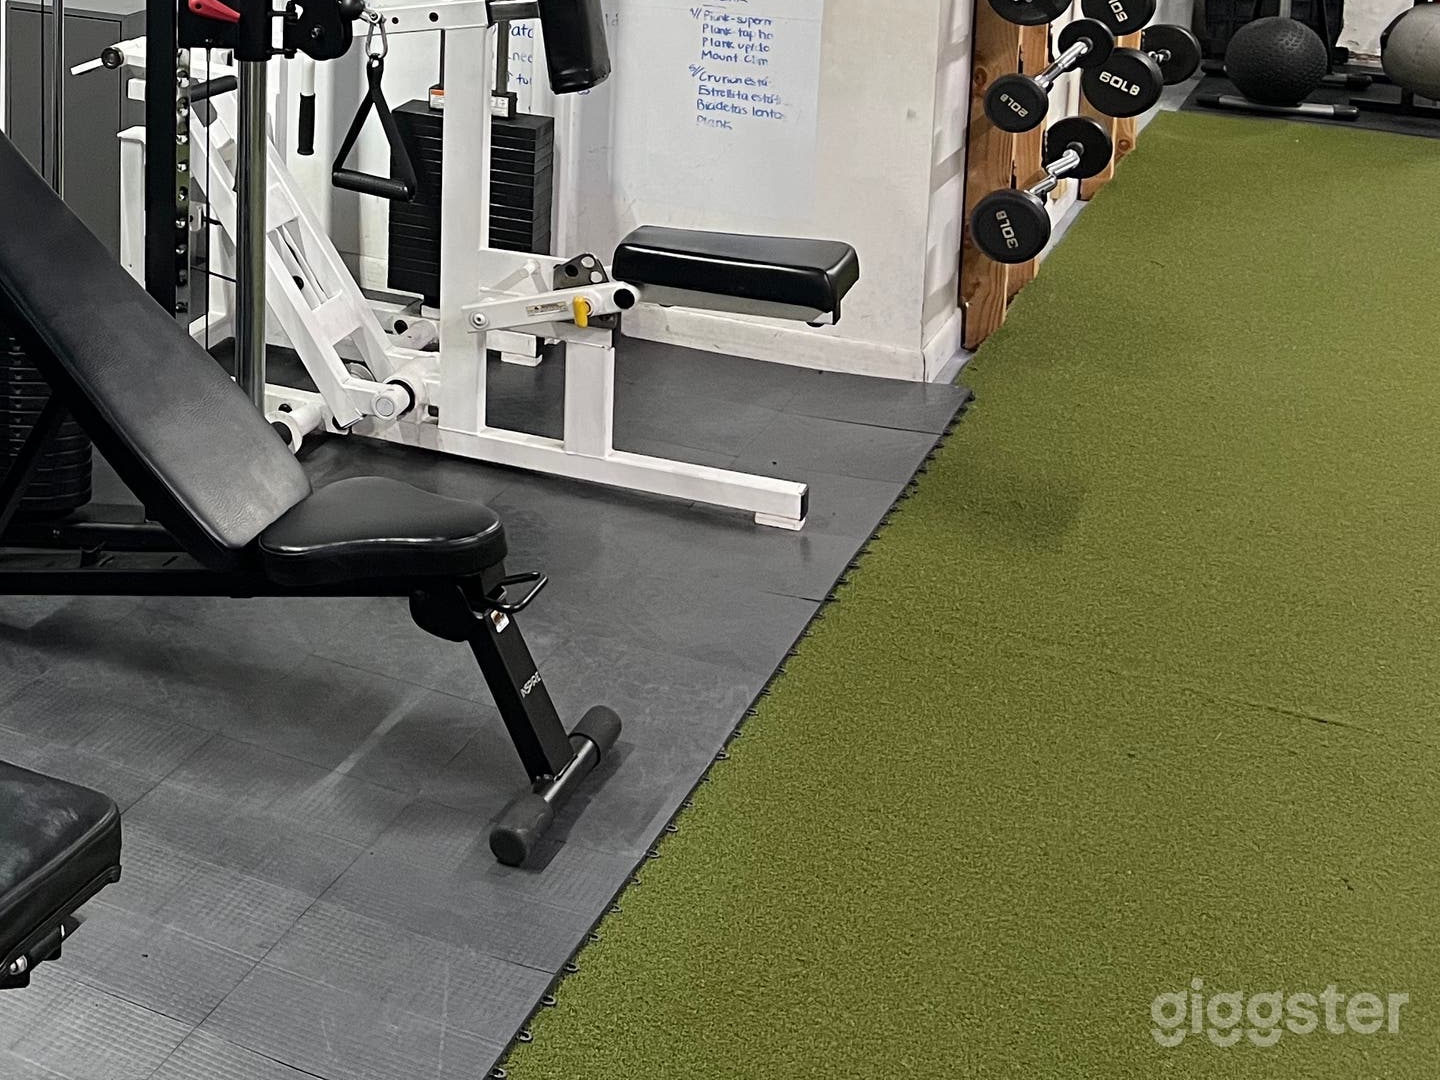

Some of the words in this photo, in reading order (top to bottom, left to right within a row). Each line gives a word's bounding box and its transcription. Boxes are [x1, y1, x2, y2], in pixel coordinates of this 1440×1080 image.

[701, 50, 738, 64] Mount
[1099, 71, 1141, 97] 60LB
[1000, 93, 1029, 118] 20LB
[995, 210, 1020, 250] 30LB
